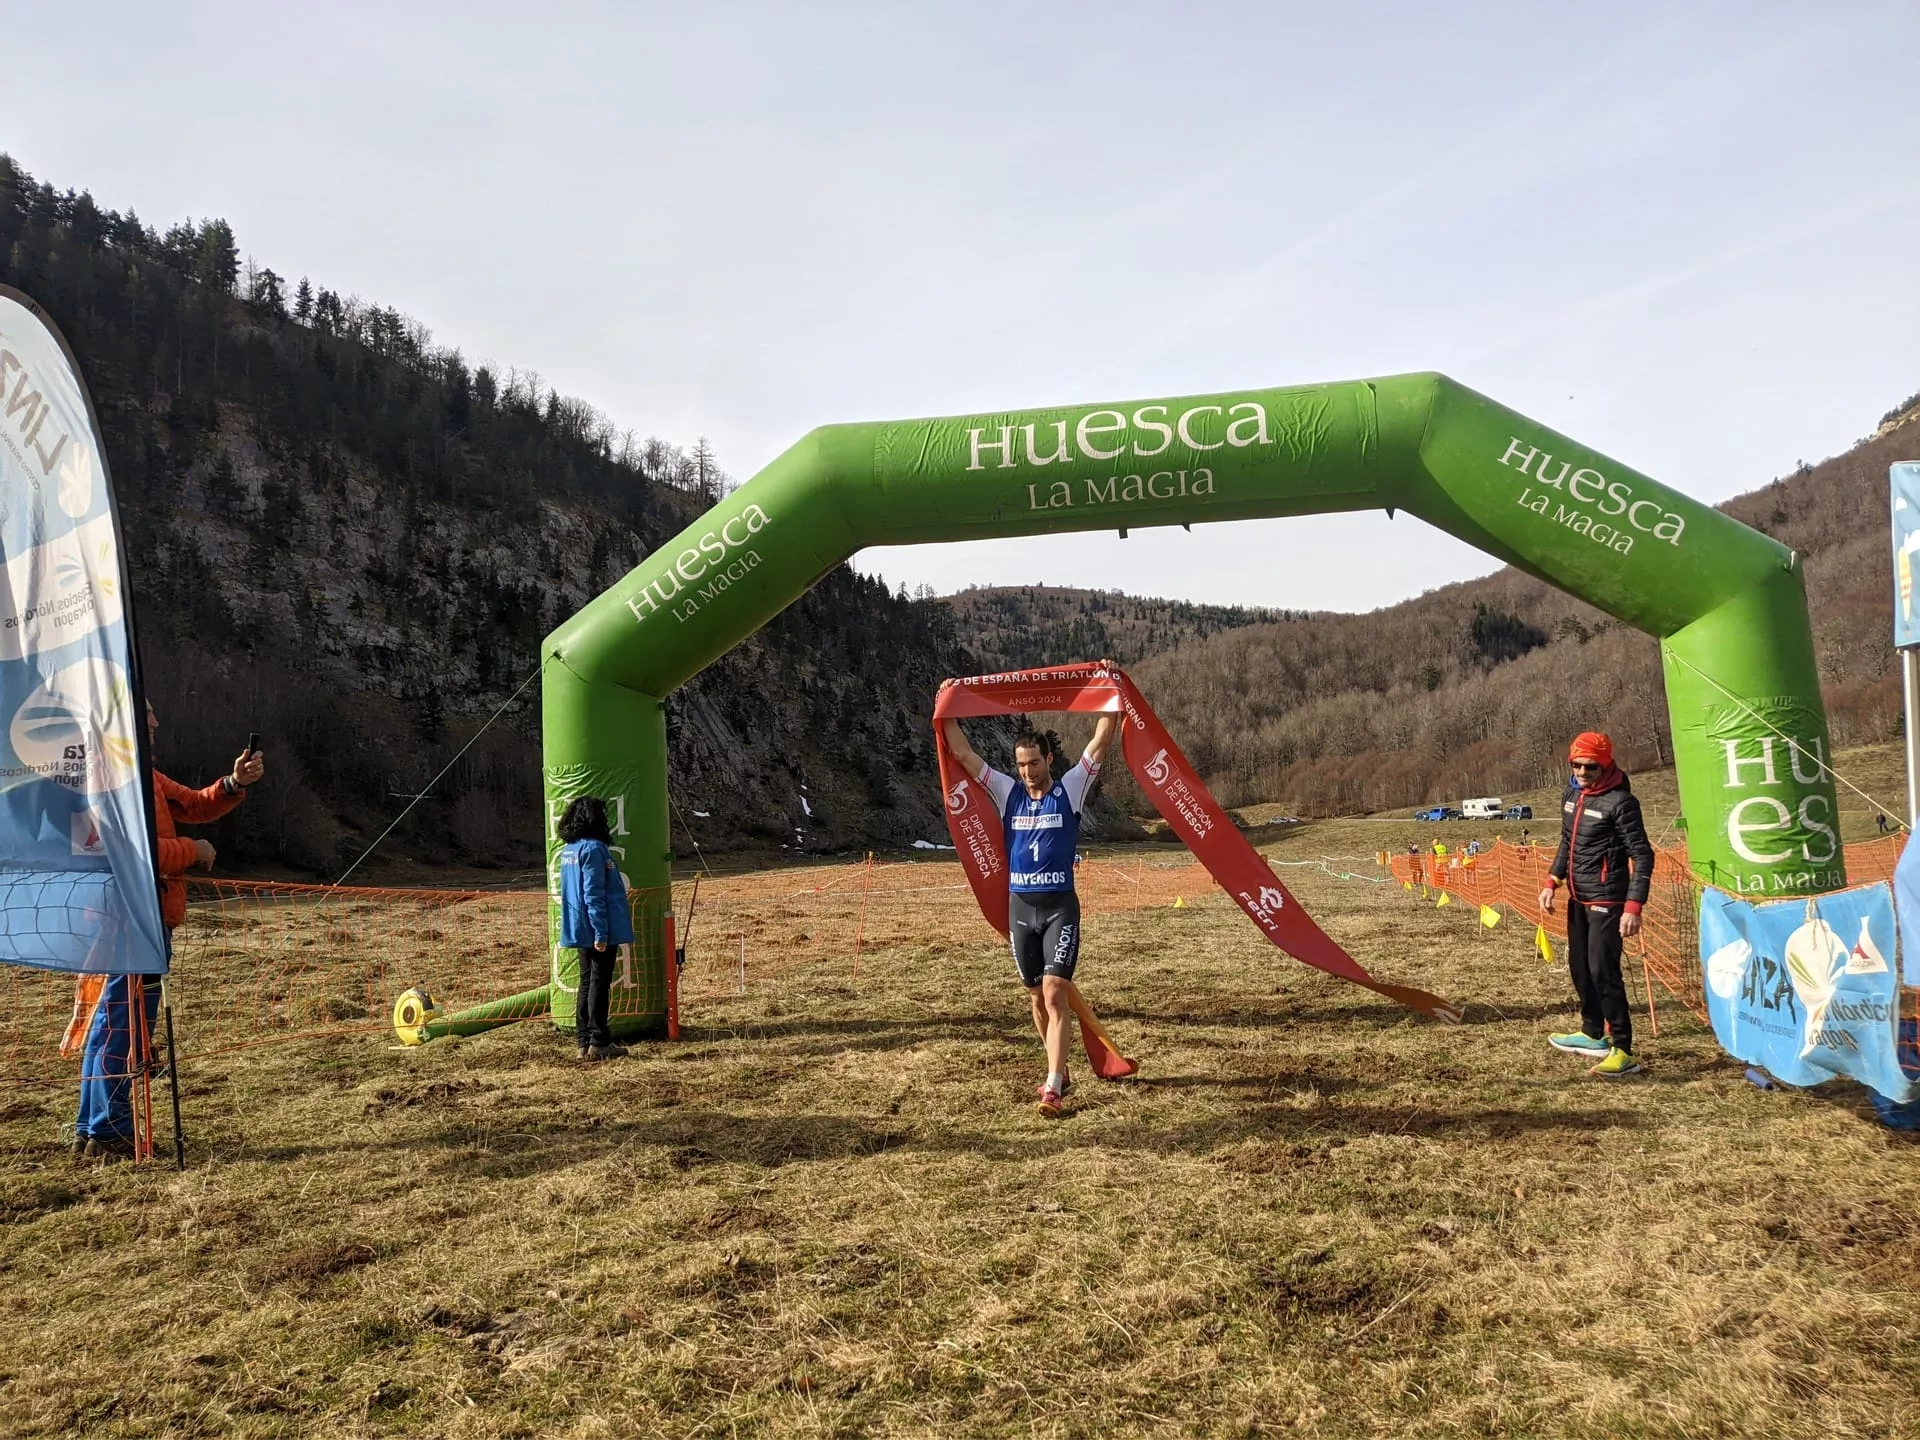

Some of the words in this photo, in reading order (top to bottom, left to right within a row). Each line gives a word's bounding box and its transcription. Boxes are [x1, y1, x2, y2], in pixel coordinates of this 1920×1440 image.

[965, 402, 1274, 471] Huesca
[1025, 480, 1075, 510] La
[1497, 436, 1686, 546] Huesca
[1517, 487, 1550, 516] La
[625, 503, 772, 624] Huesca
[672, 598, 700, 624] La
[963, 676, 980, 686] DE
[982, 672, 1029, 684] ESPAÑA
[1032, 672, 1048, 682] DE
[1038, 695, 1062, 705] 2024
[1164, 786, 1179, 802] DE
[1175, 799, 1207, 840] HUESCA
[1173, 778, 1214, 831] DIPUTACIÓN
[959, 819, 972, 835] DE
[966, 835, 992, 880] HUESCA
[969, 814, 1001, 873] DIPUTACIÓN
[1028, 840, 1039, 862] 1
[1010, 871, 1066, 886] MAYENCOS
[1053, 923, 1074, 964] PEÑOTA
